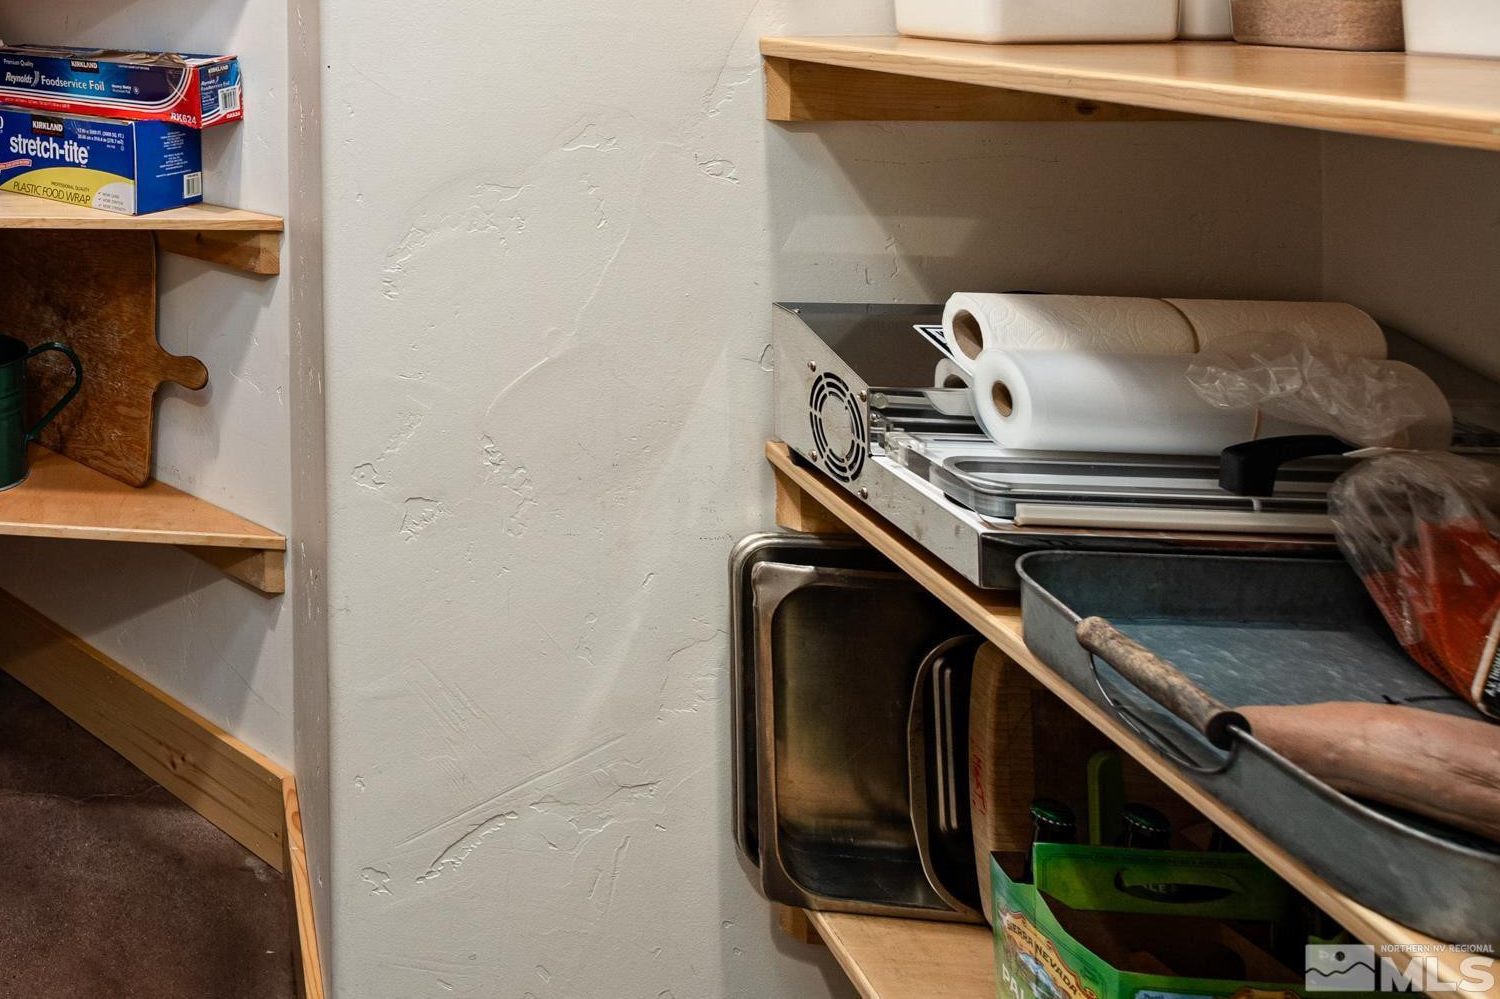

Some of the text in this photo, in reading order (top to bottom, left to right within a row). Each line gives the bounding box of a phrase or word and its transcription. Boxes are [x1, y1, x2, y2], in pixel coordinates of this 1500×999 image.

[3, 58, 34, 68] Premium Quality
[71, 60, 98, 69] KIRKLAND
[208, 64, 229, 74] KIRKLAND
[5, 72, 33, 85] Reynolds
[41, 74, 105, 92] Foodservice Foil
[170, 112, 197, 125] RK624
[32, 120, 64, 133] KIRKLAND
[9, 134, 89, 165] stretch-tite
[13, 181, 91, 205] PLASTIC FOOD WRAP
[1007, 921, 1079, 997] SIERRA NEVADA
[1002, 963, 1025, 999] PAL
